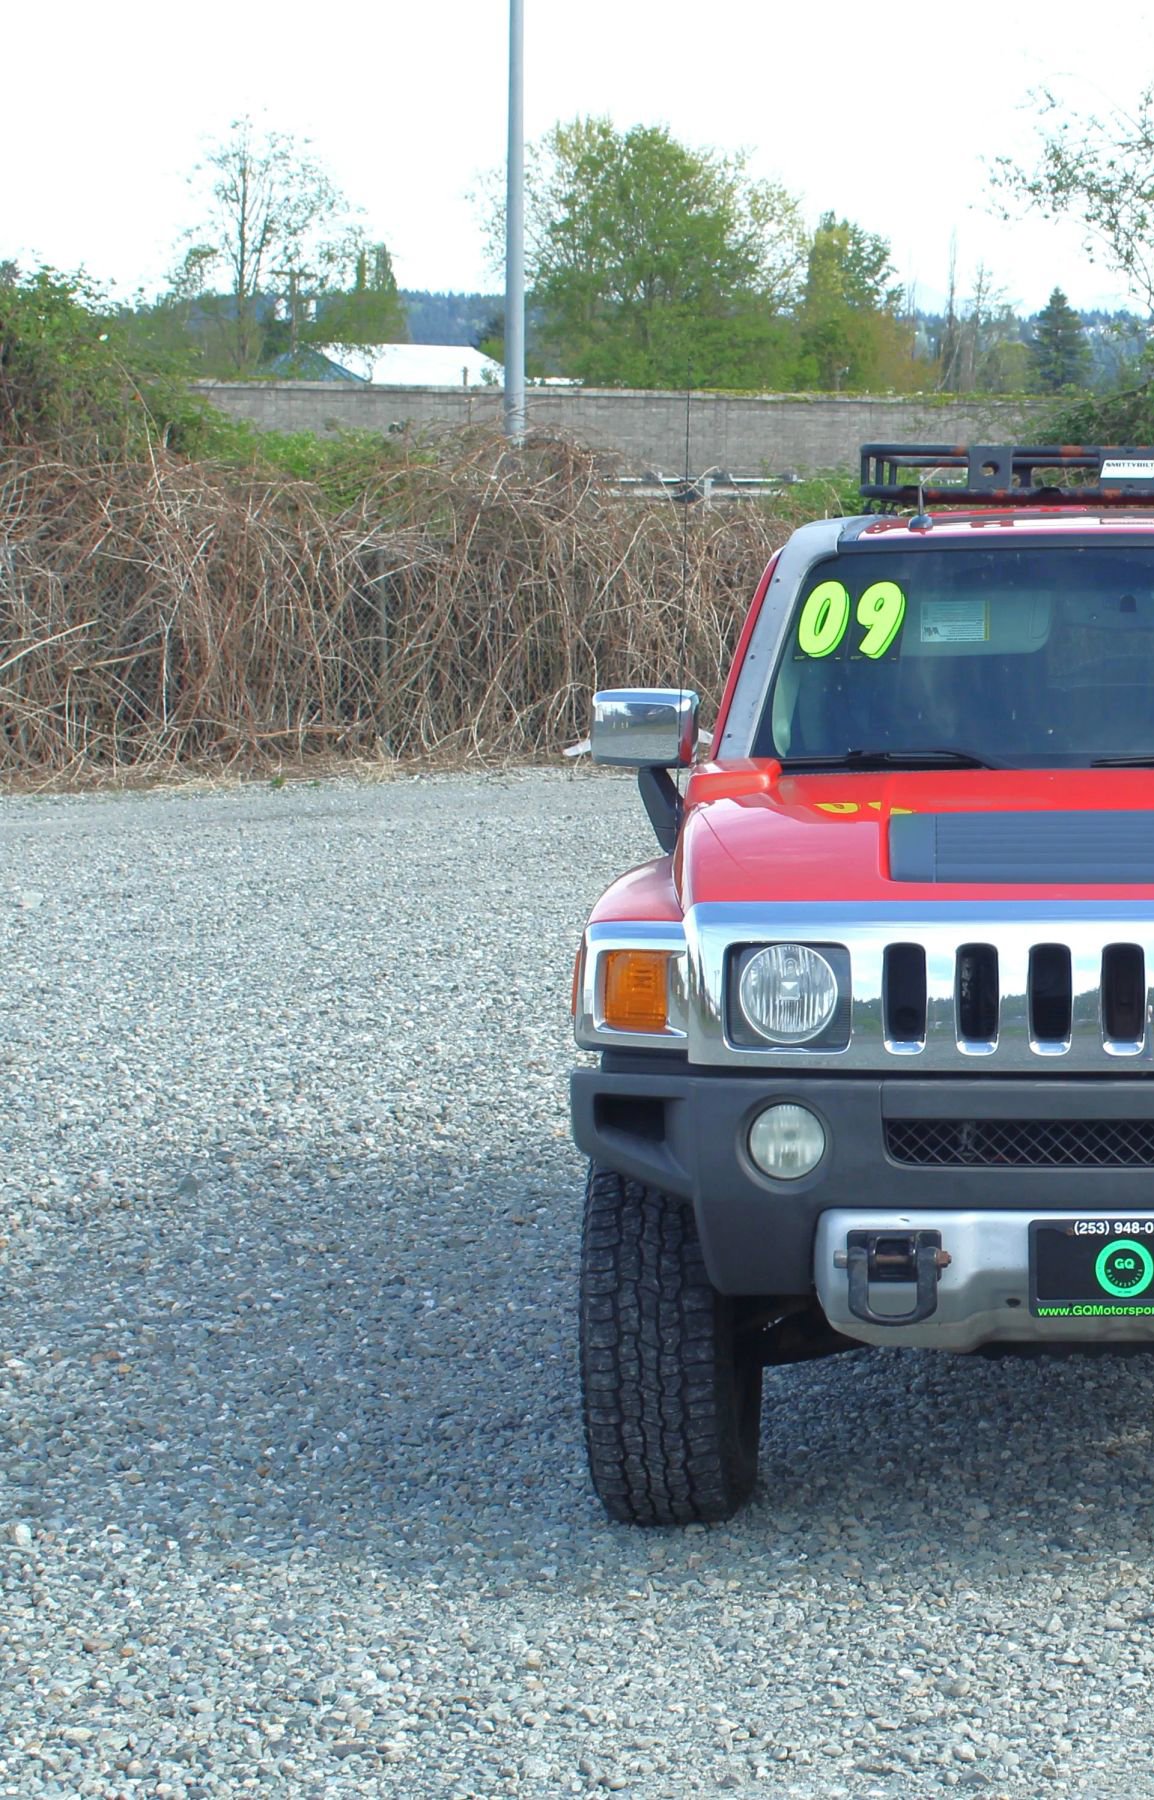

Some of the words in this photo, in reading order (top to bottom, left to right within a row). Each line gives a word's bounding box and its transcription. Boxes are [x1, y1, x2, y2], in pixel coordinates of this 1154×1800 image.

[797, 579, 906, 661] 09
[1074, 1221, 1110, 1235] (253)
[1114, 1258, 1135, 1269] GQ
